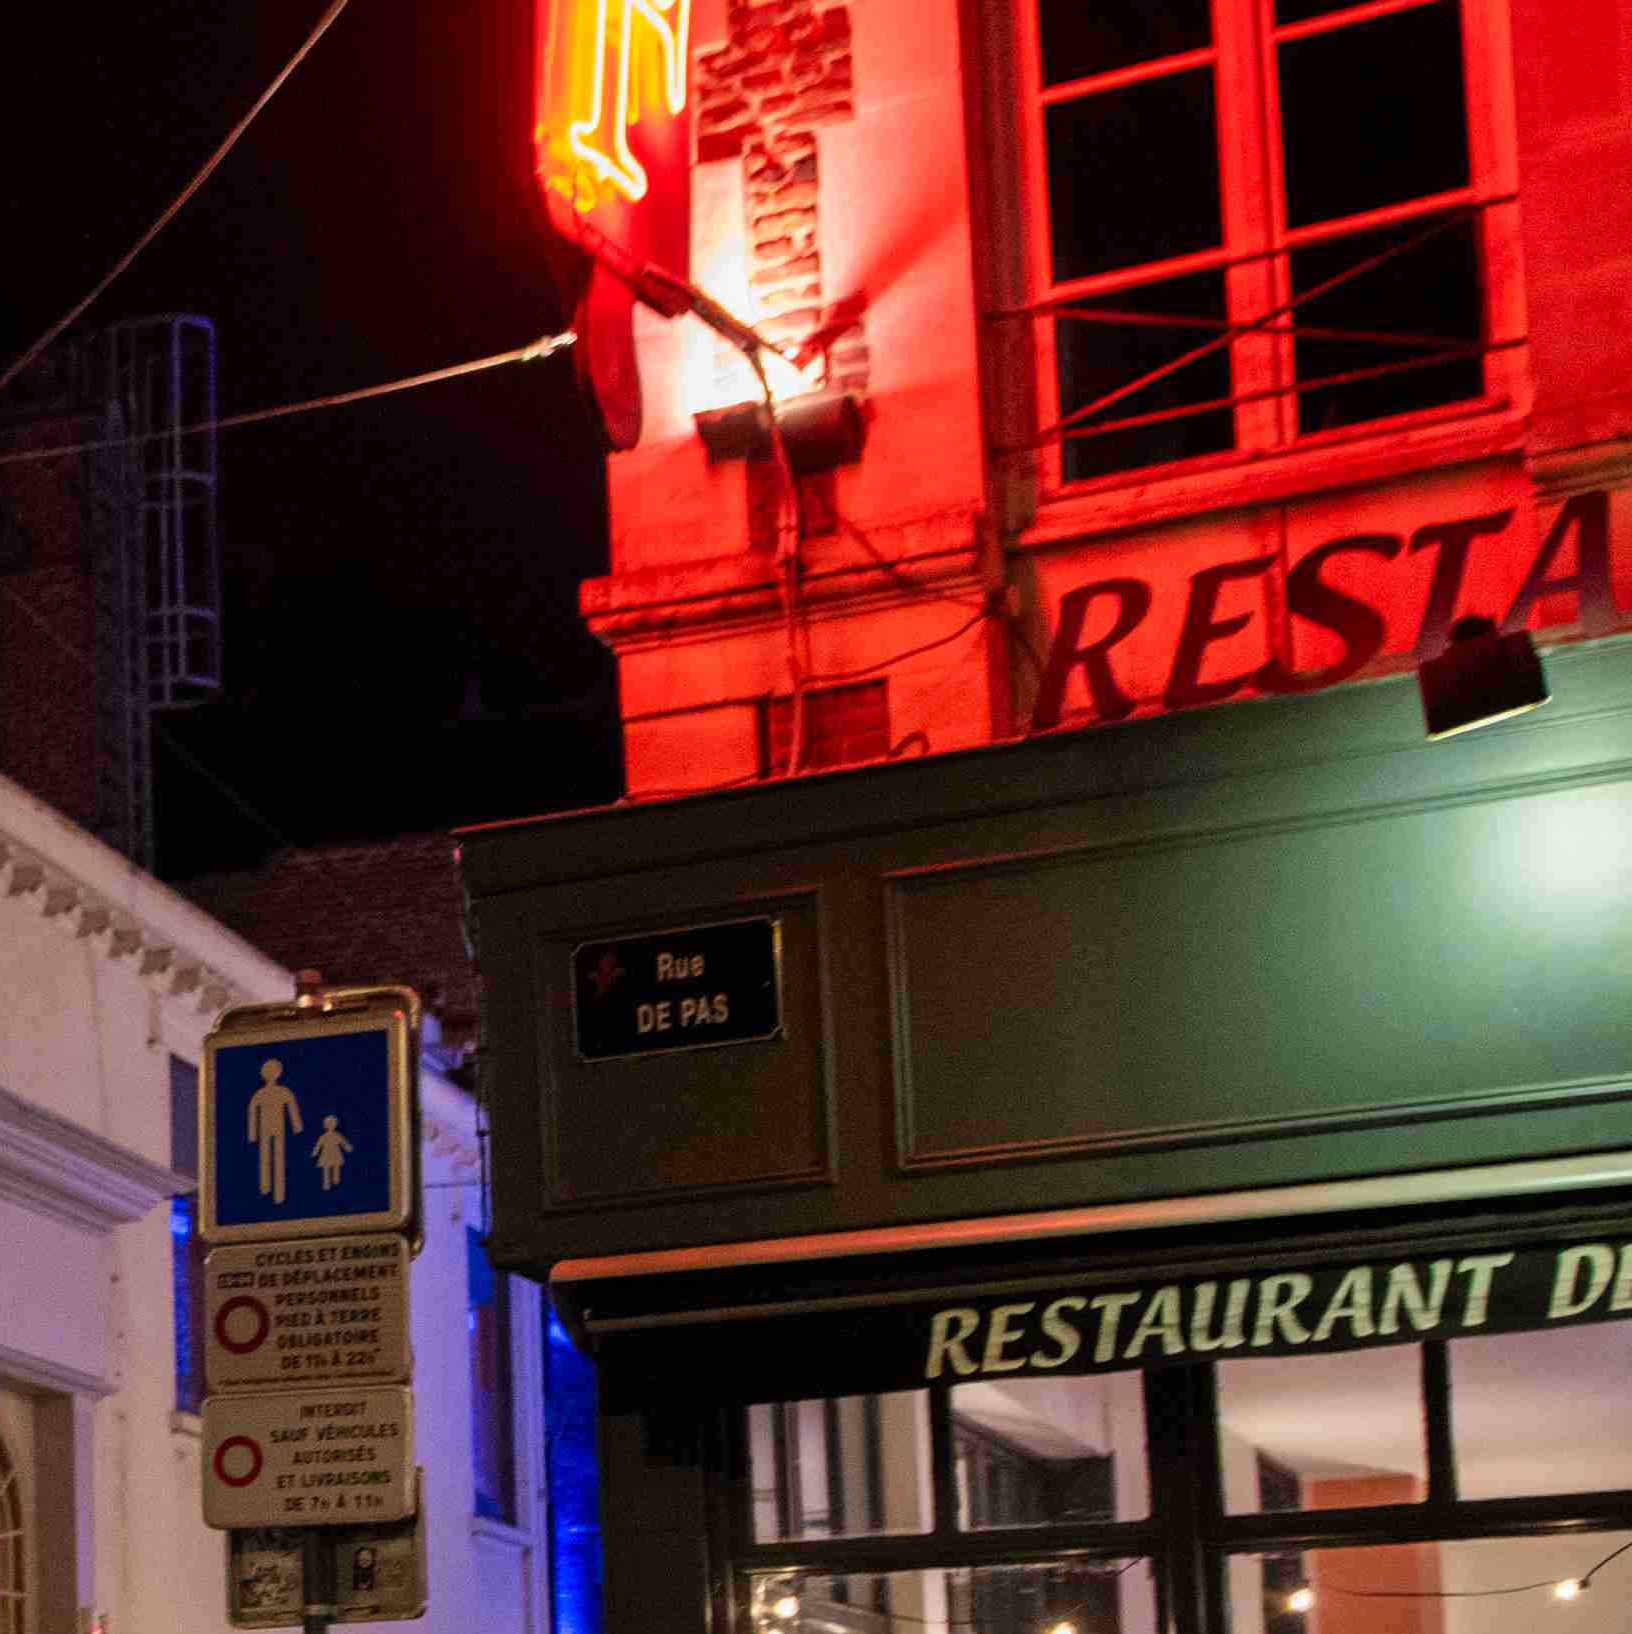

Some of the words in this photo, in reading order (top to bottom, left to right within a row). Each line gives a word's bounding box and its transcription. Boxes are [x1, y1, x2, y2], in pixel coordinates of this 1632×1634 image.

[1034, 491, 1619, 736] RESTA
[656, 952, 705, 982] Rue
[636, 1001, 671, 1033] DE
[681, 994, 730, 1027] PAS
[255, 1249, 315, 1267] CYCLES
[319, 1247, 340, 1263] ET
[258, 1273, 279, 1289] DE
[274, 1313, 312, 1328] PIED
[924, 1252, 1514, 1380] RESTAURANT
[281, 1354, 301, 1370] DE
[300, 1402, 367, 1420] INTERDIT
[269, 1427, 309, 1443] SAUF
[316, 1421, 400, 1441] VÉHICULES
[277, 1474, 295, 1489] ET
[302, 1470, 392, 1488] LIVRAISONS
[284, 1497, 304, 1512] DE
